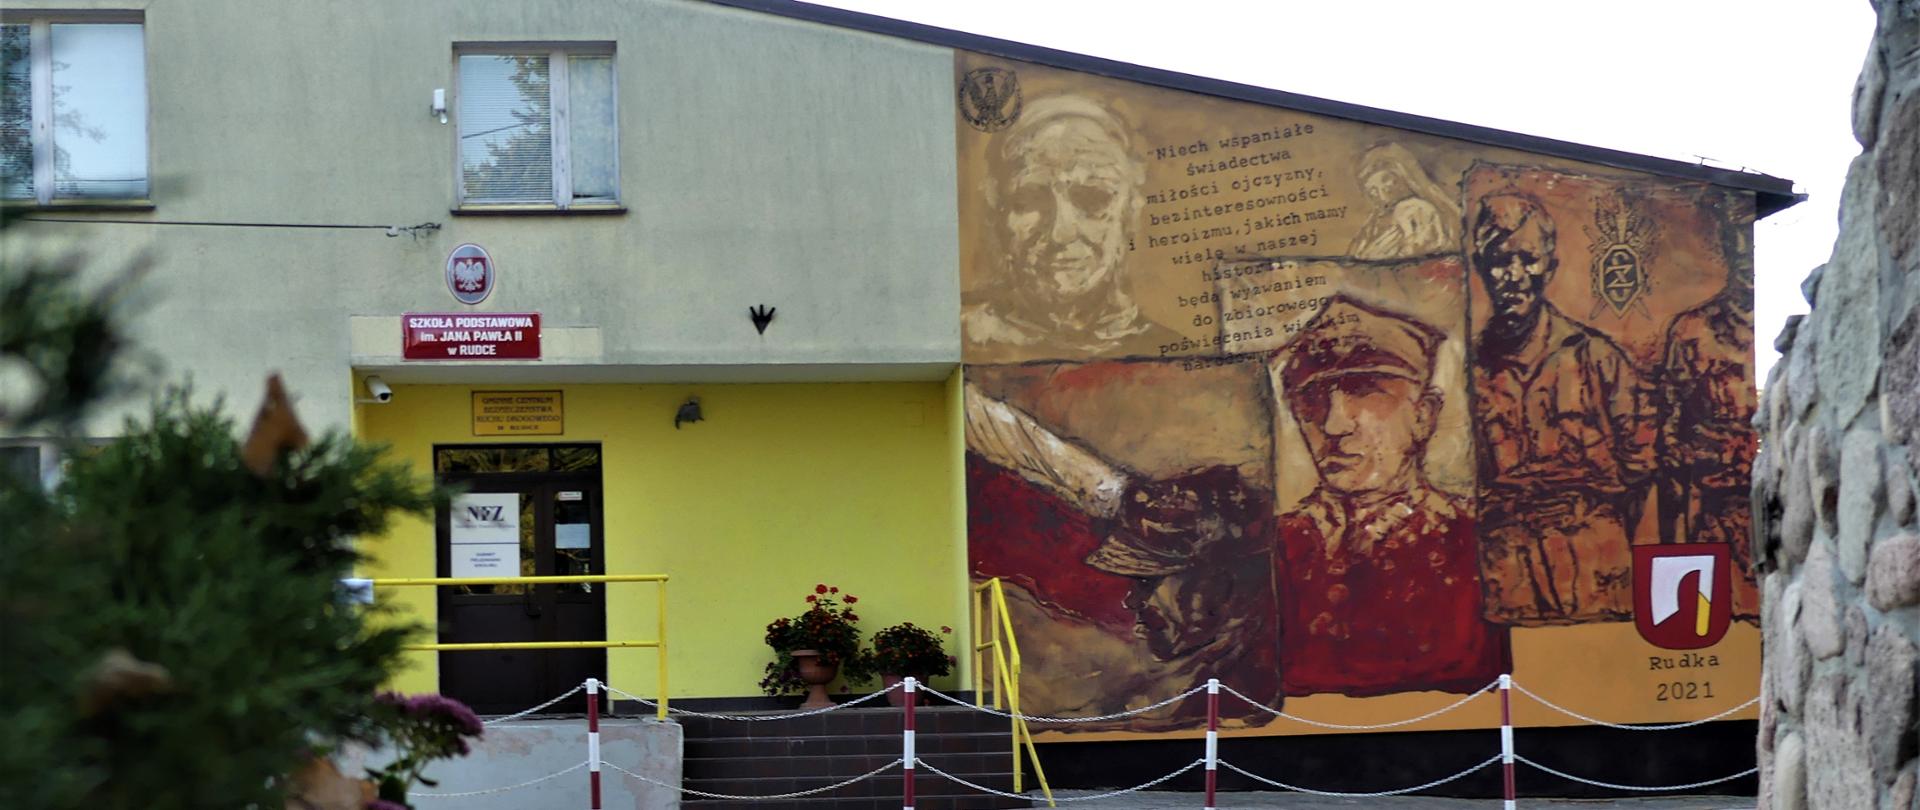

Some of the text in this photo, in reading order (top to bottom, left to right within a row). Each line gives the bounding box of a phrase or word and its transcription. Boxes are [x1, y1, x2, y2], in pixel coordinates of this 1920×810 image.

[1218, 123, 1314, 148] wspaniałe
[1186, 150, 1292, 176] świadectwa
[1146, 168, 1323, 205] miłości ojczyzny,
[1150, 185, 1329, 226] bezinteresowności
[1128, 239, 1136, 251] i
[1304, 205, 1348, 222] mamy
[1234, 244, 1246, 254] w
[1257, 230, 1318, 252] naszej
[1230, 274, 1327, 300] wyzwaniem
[409, 317, 533, 328] SZKOŁA PODSTAWOWA
[1192, 295, 1328, 327] do zbiorowego
[420, 331, 523, 342] im. JANA PAWŁA II
[447, 345, 497, 355] w RUDCE
[466, 505, 505, 522] NFZ
[1649, 653, 1720, 671] Rudka
[1656, 681, 1715, 701] 2021
